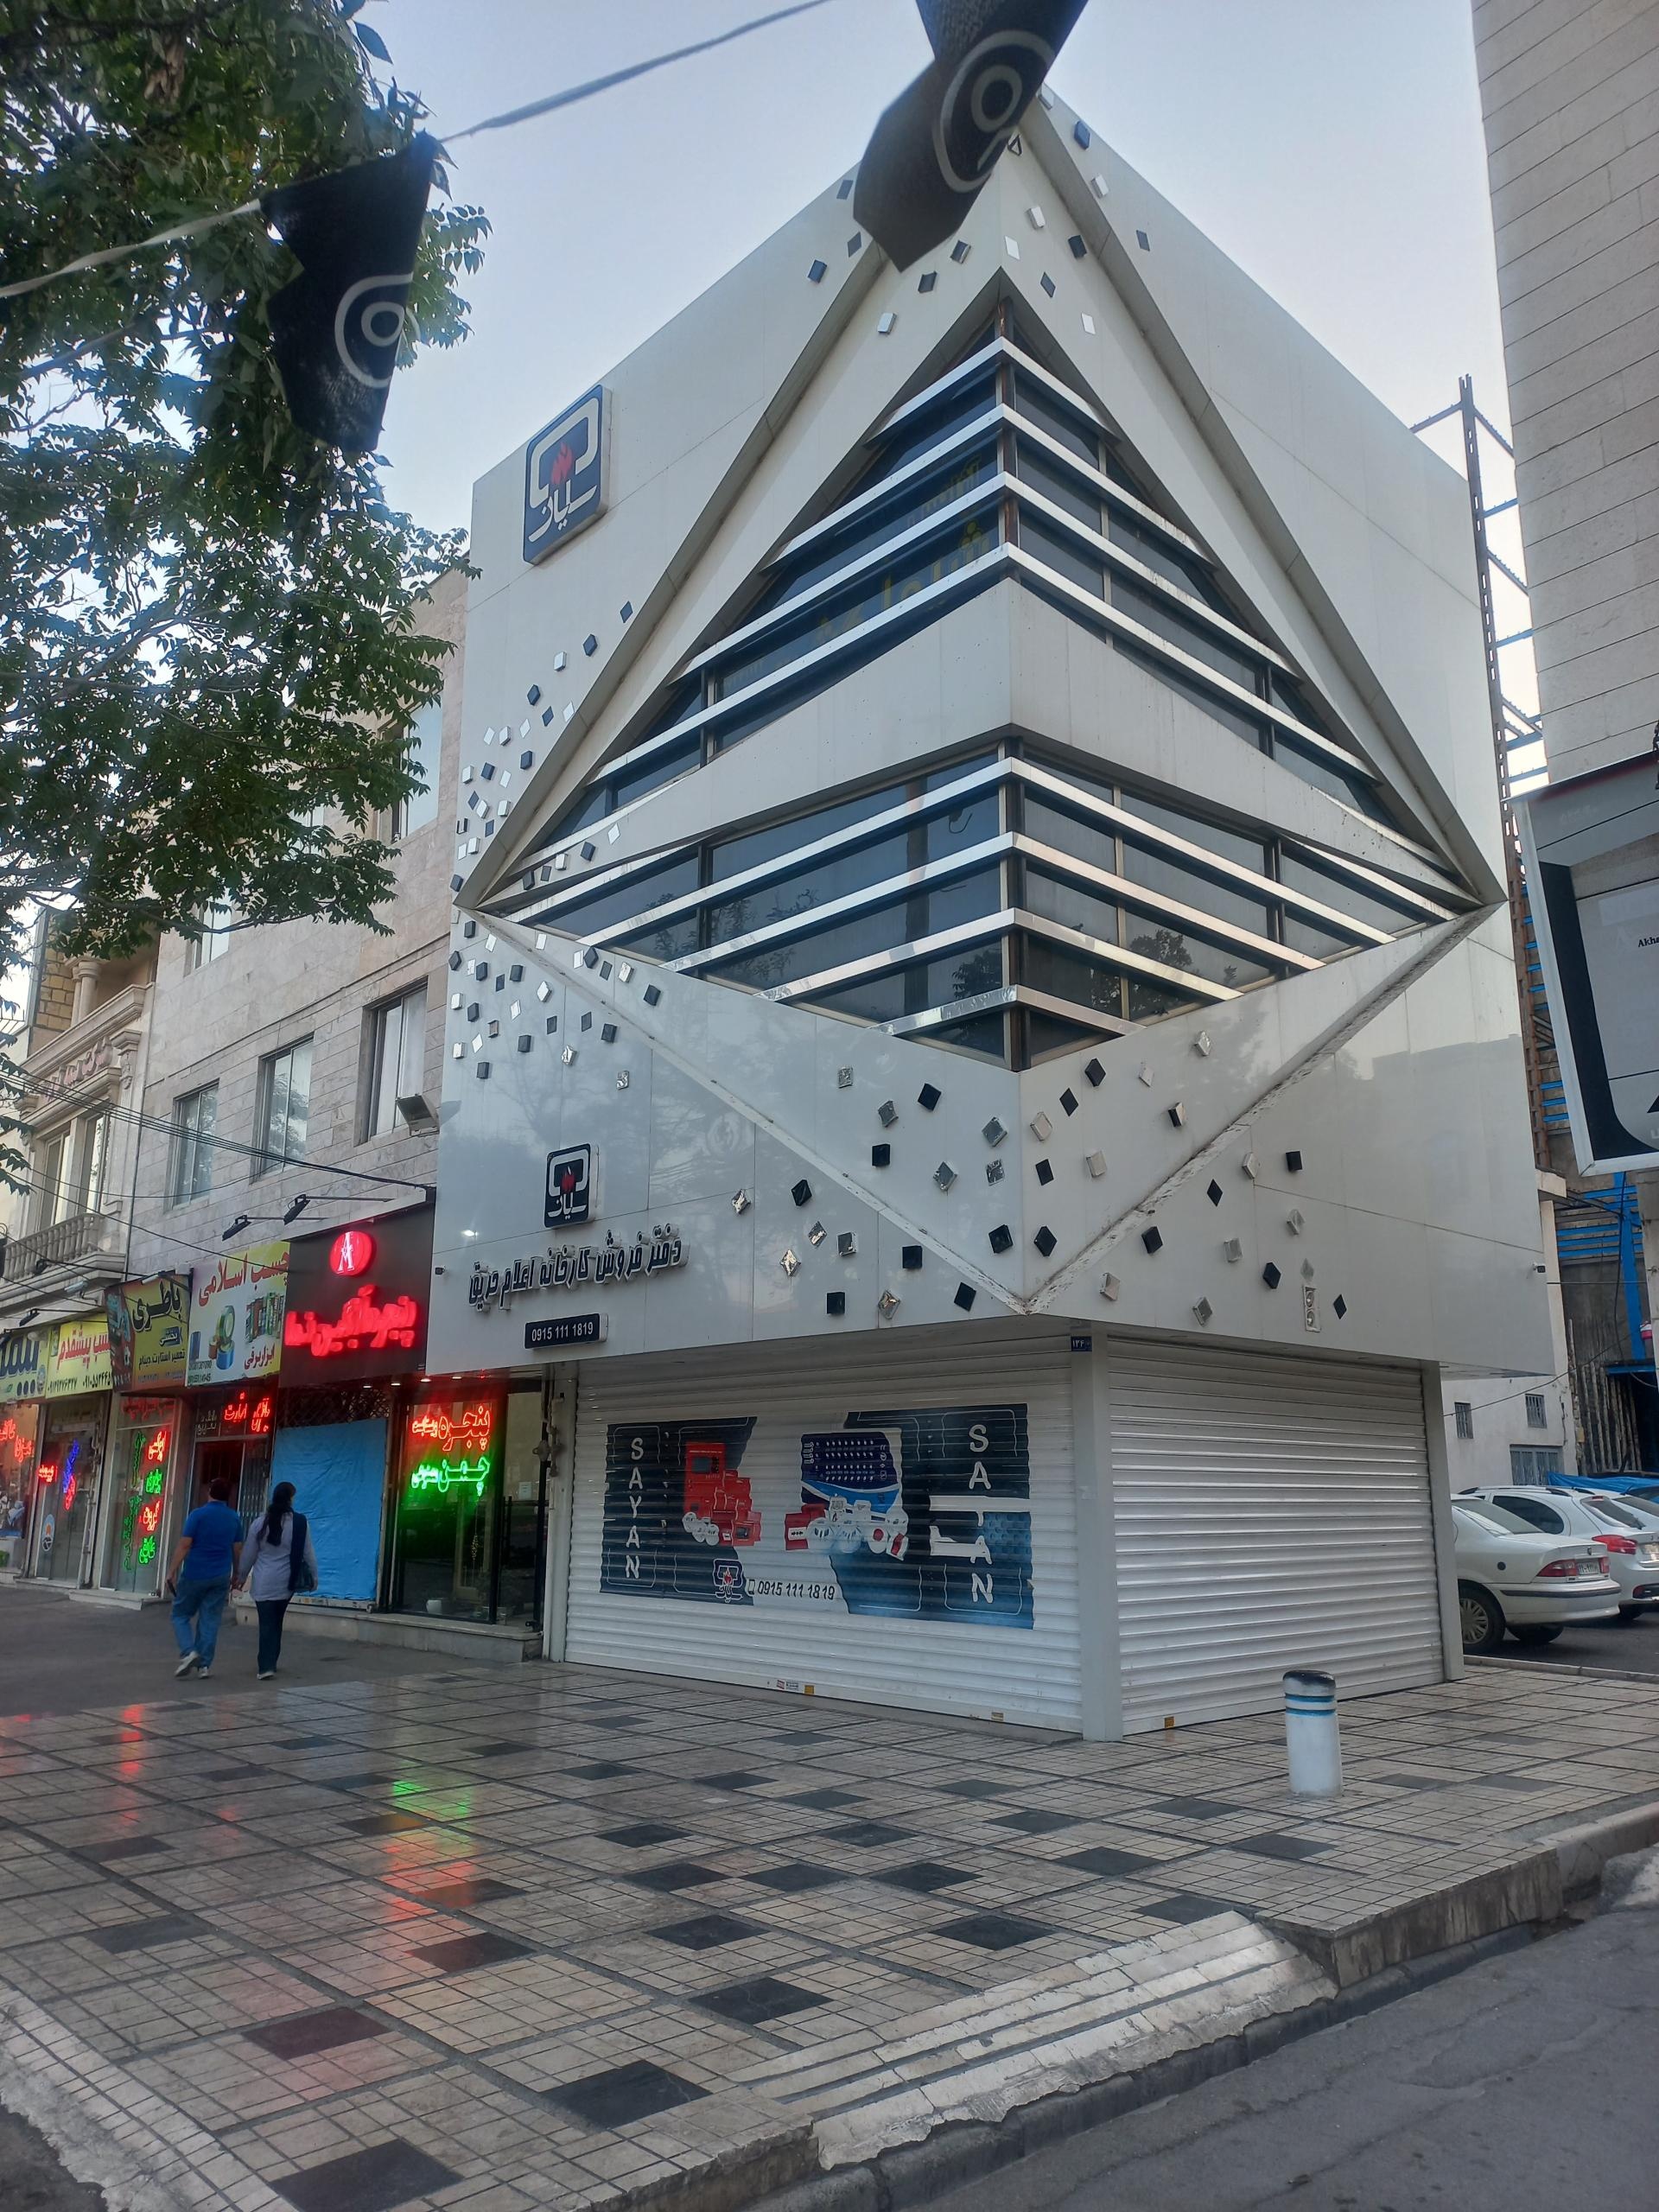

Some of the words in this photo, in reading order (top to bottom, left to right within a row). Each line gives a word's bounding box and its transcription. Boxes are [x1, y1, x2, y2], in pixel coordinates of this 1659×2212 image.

[539, 1243, 594, 1288] کارخانه
[594, 1229, 647, 1284] فروش
[645, 1224, 685, 1276] دفتر
[198, 1252, 248, 1307] اسلامی
[468, 1261, 499, 1313] حریق
[500, 1257, 536, 1310] اعلام
[531, 1325, 553, 1342] 0915
[555, 1325, 569, 1339] 111
[572, 1321, 594, 1338] 1819
[624, 1436, 646, 1580] SAYAN
[757, 1580, 783, 1596] 0915
[785, 1582, 804, 1598] 111
[807, 1584, 836, 1600] 1819
